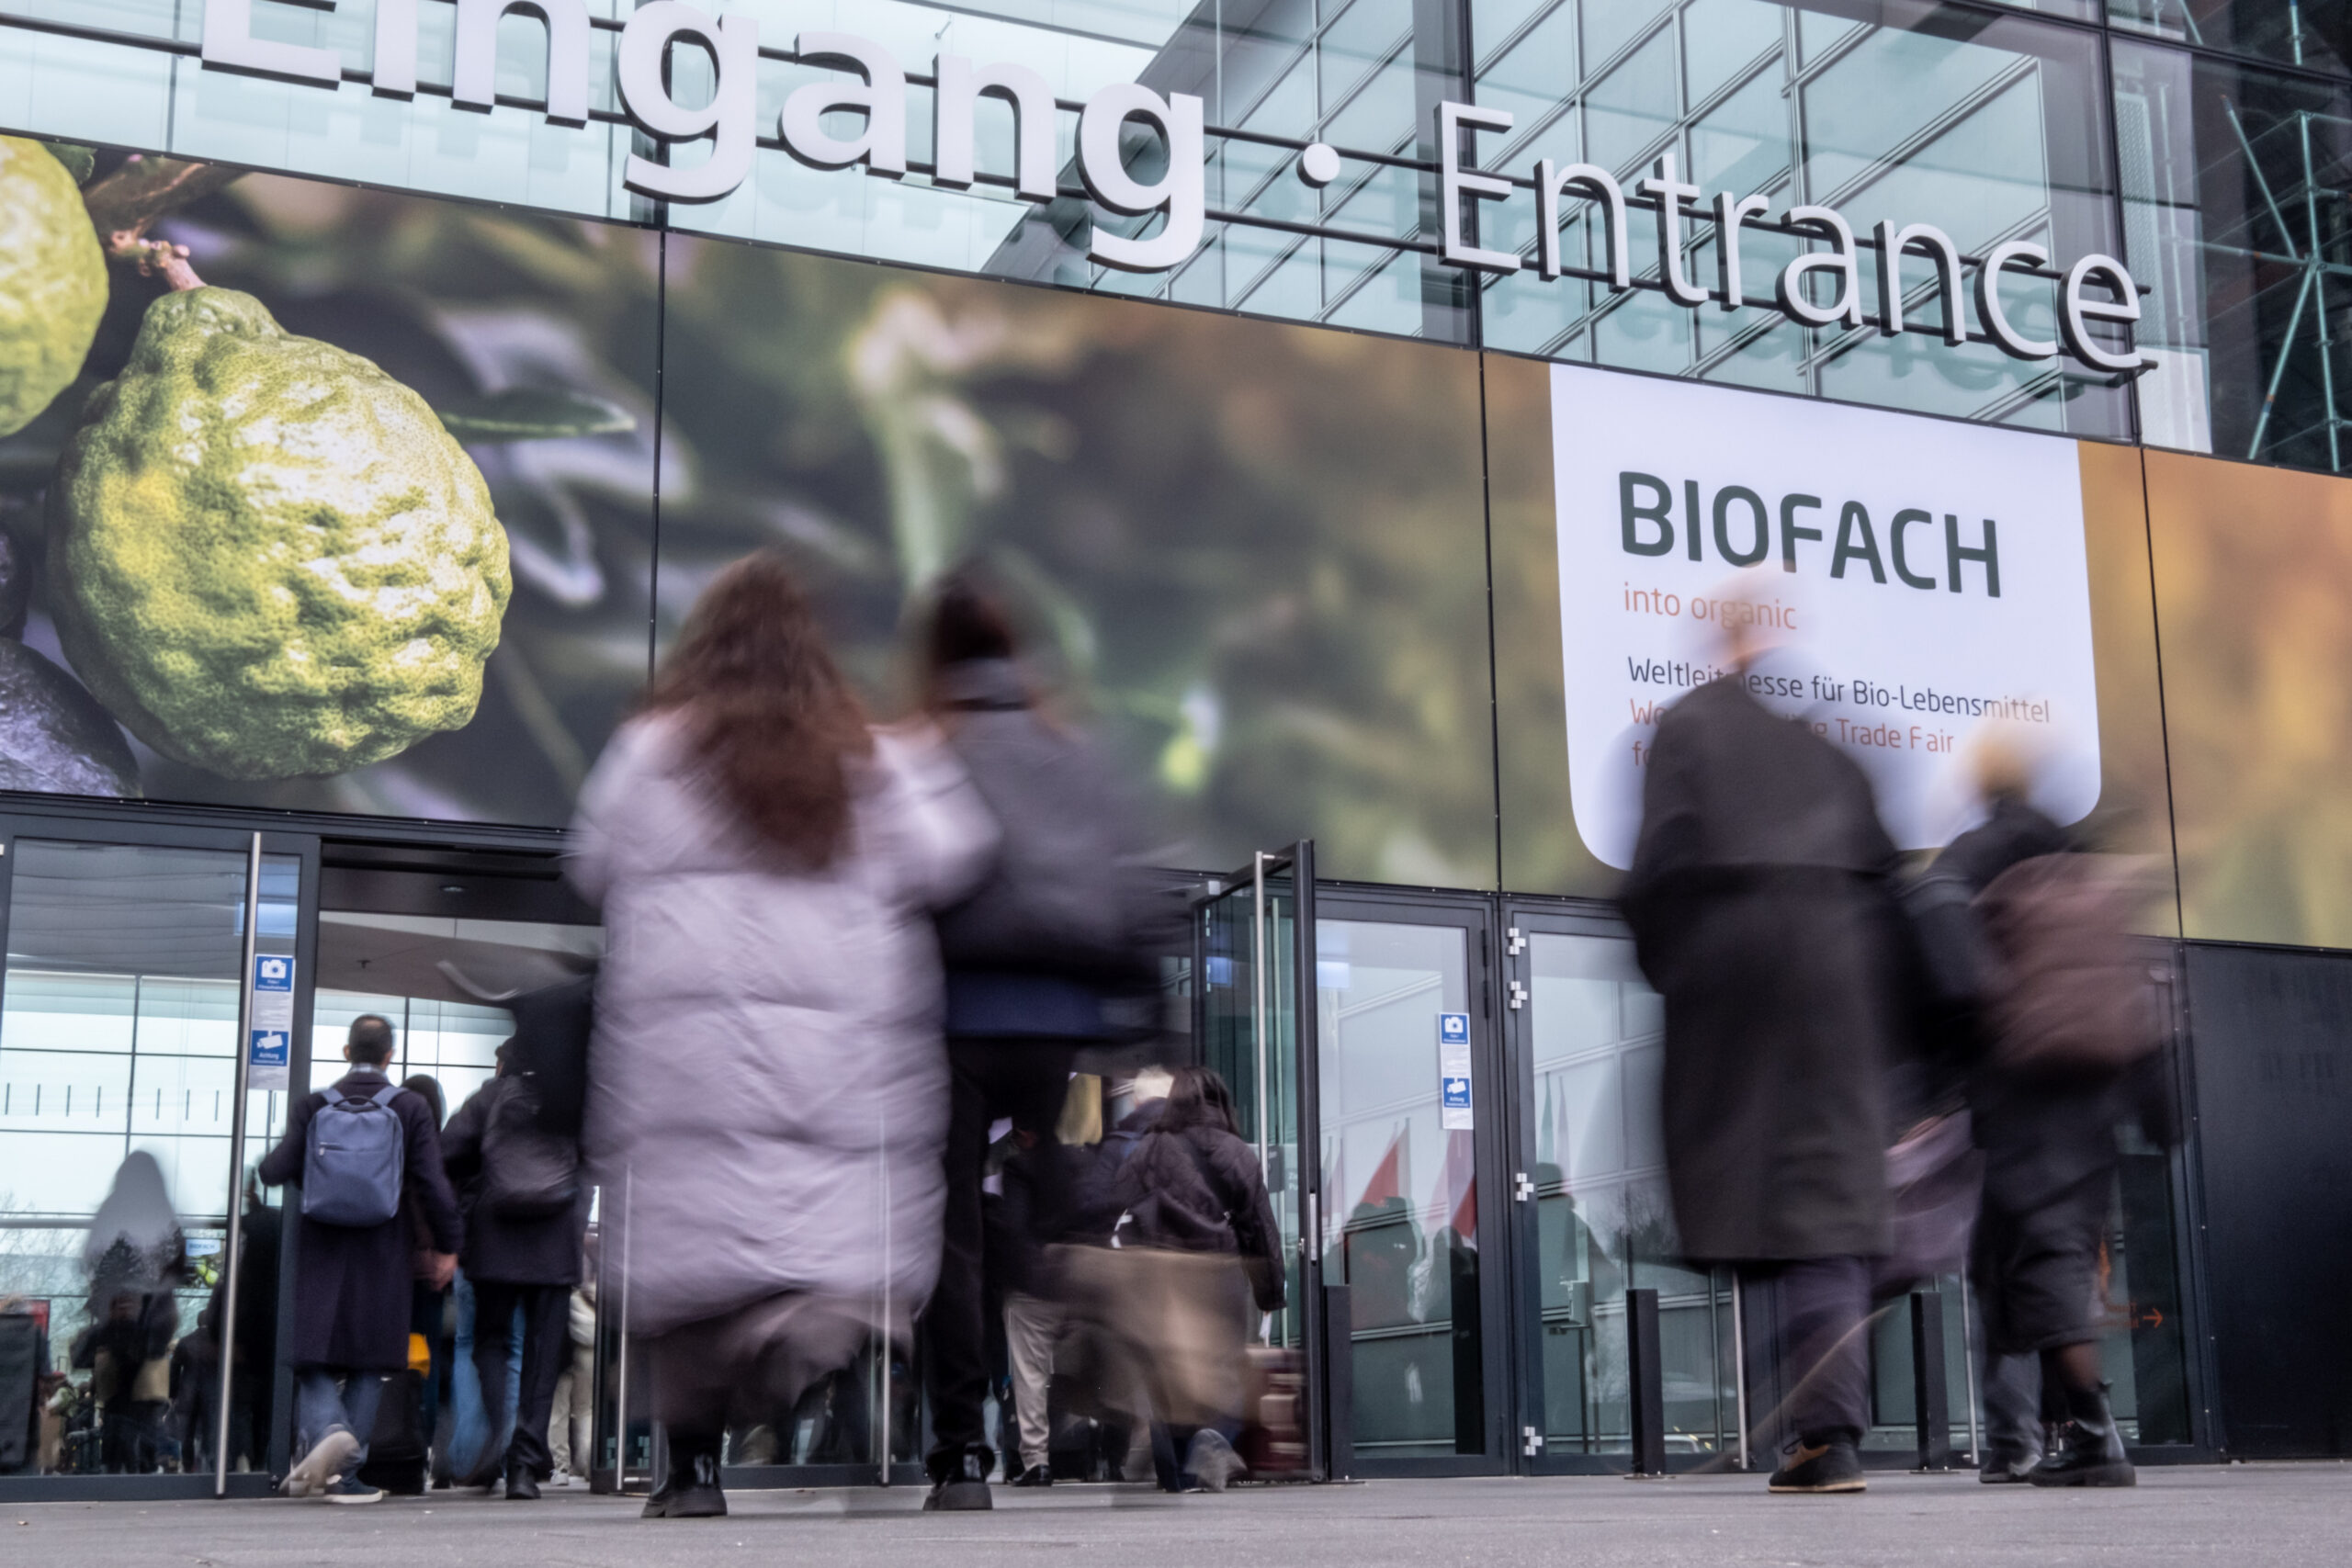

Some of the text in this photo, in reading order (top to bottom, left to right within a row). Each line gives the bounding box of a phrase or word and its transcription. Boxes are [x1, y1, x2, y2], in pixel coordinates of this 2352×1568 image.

[1434, 99, 2143, 372] Entrance
[1618, 470, 2001, 599] BIOFACH
[1623, 581, 1798, 631] into organic
[1627, 656, 2051, 724] Weltleitesse für Bio-Lebensmittel
[1835, 718, 1902, 750] Trade
[1909, 726, 1954, 755] Fair
